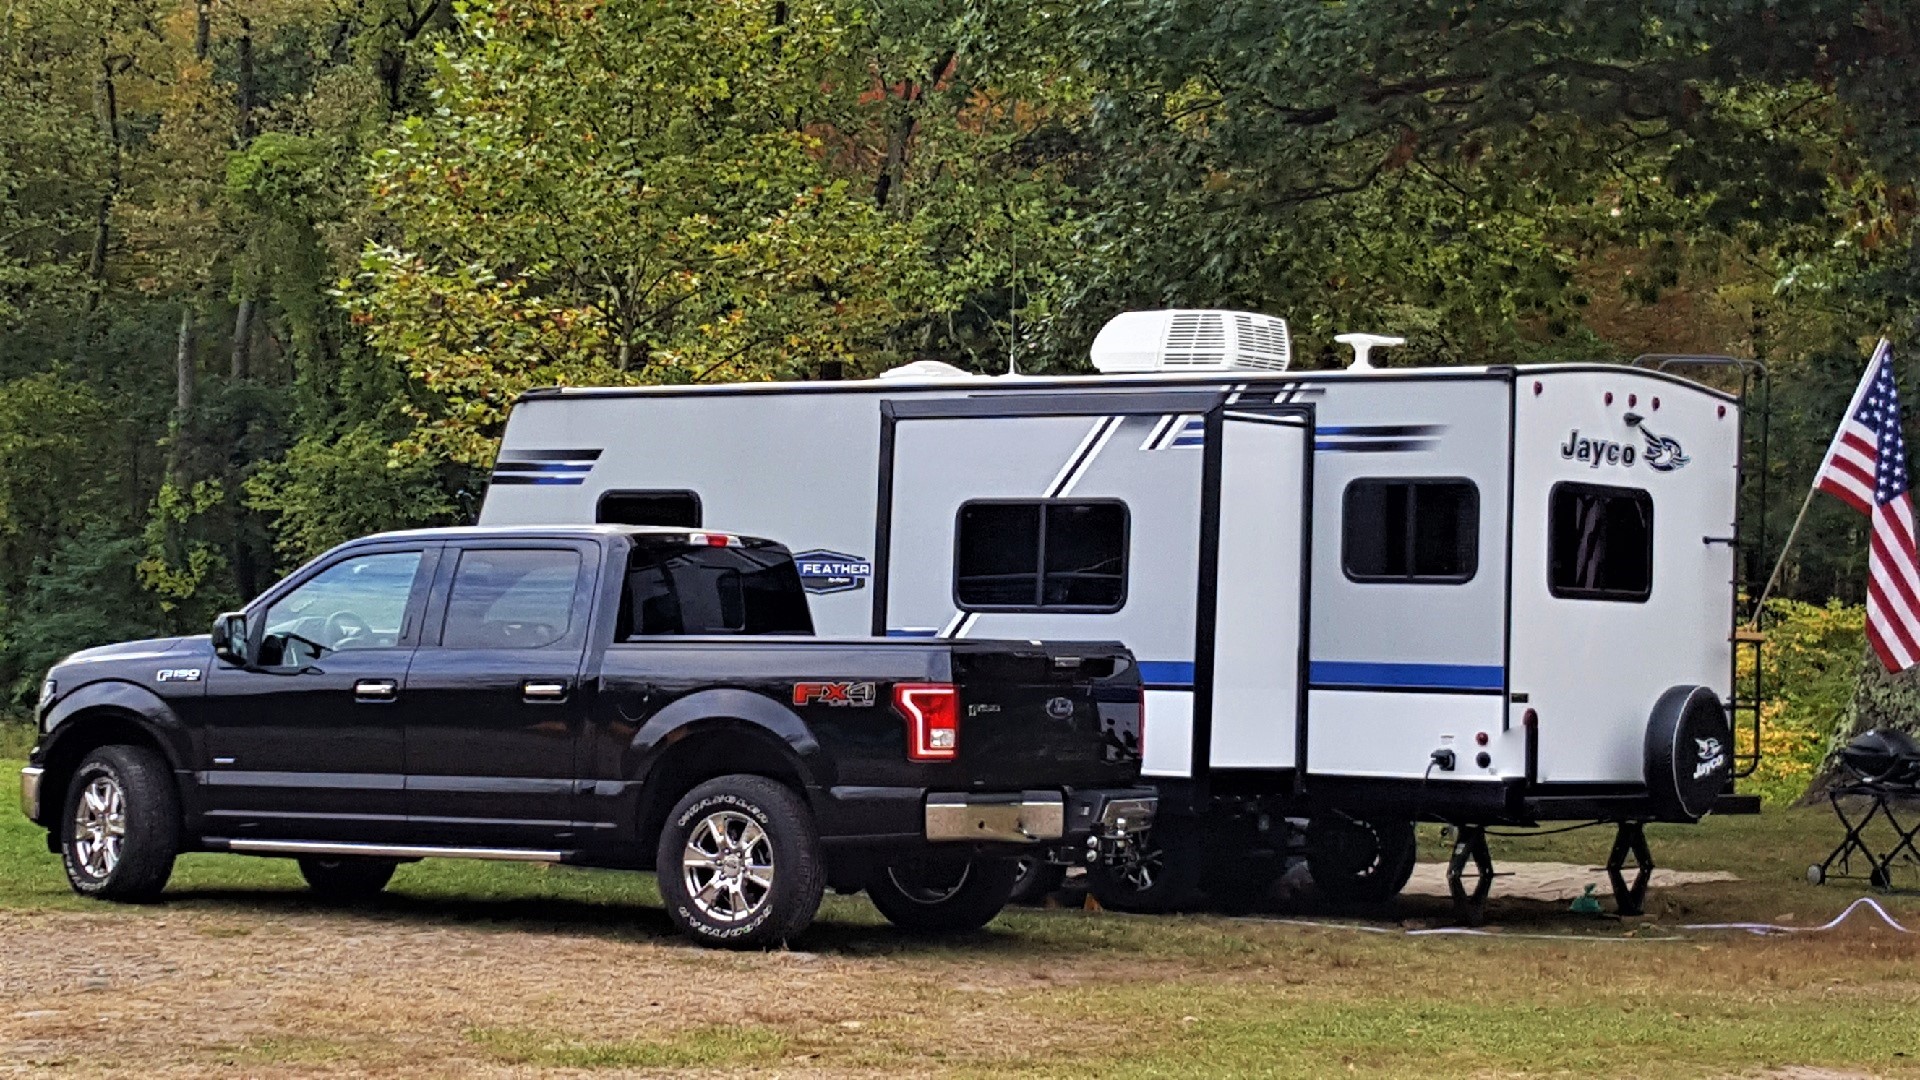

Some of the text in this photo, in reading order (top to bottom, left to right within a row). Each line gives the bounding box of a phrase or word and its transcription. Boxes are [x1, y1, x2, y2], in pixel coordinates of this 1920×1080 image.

[1561, 428, 1636, 469] Jayco
[802, 563, 870, 575] FEATHER
[793, 681, 876, 706] FX4
